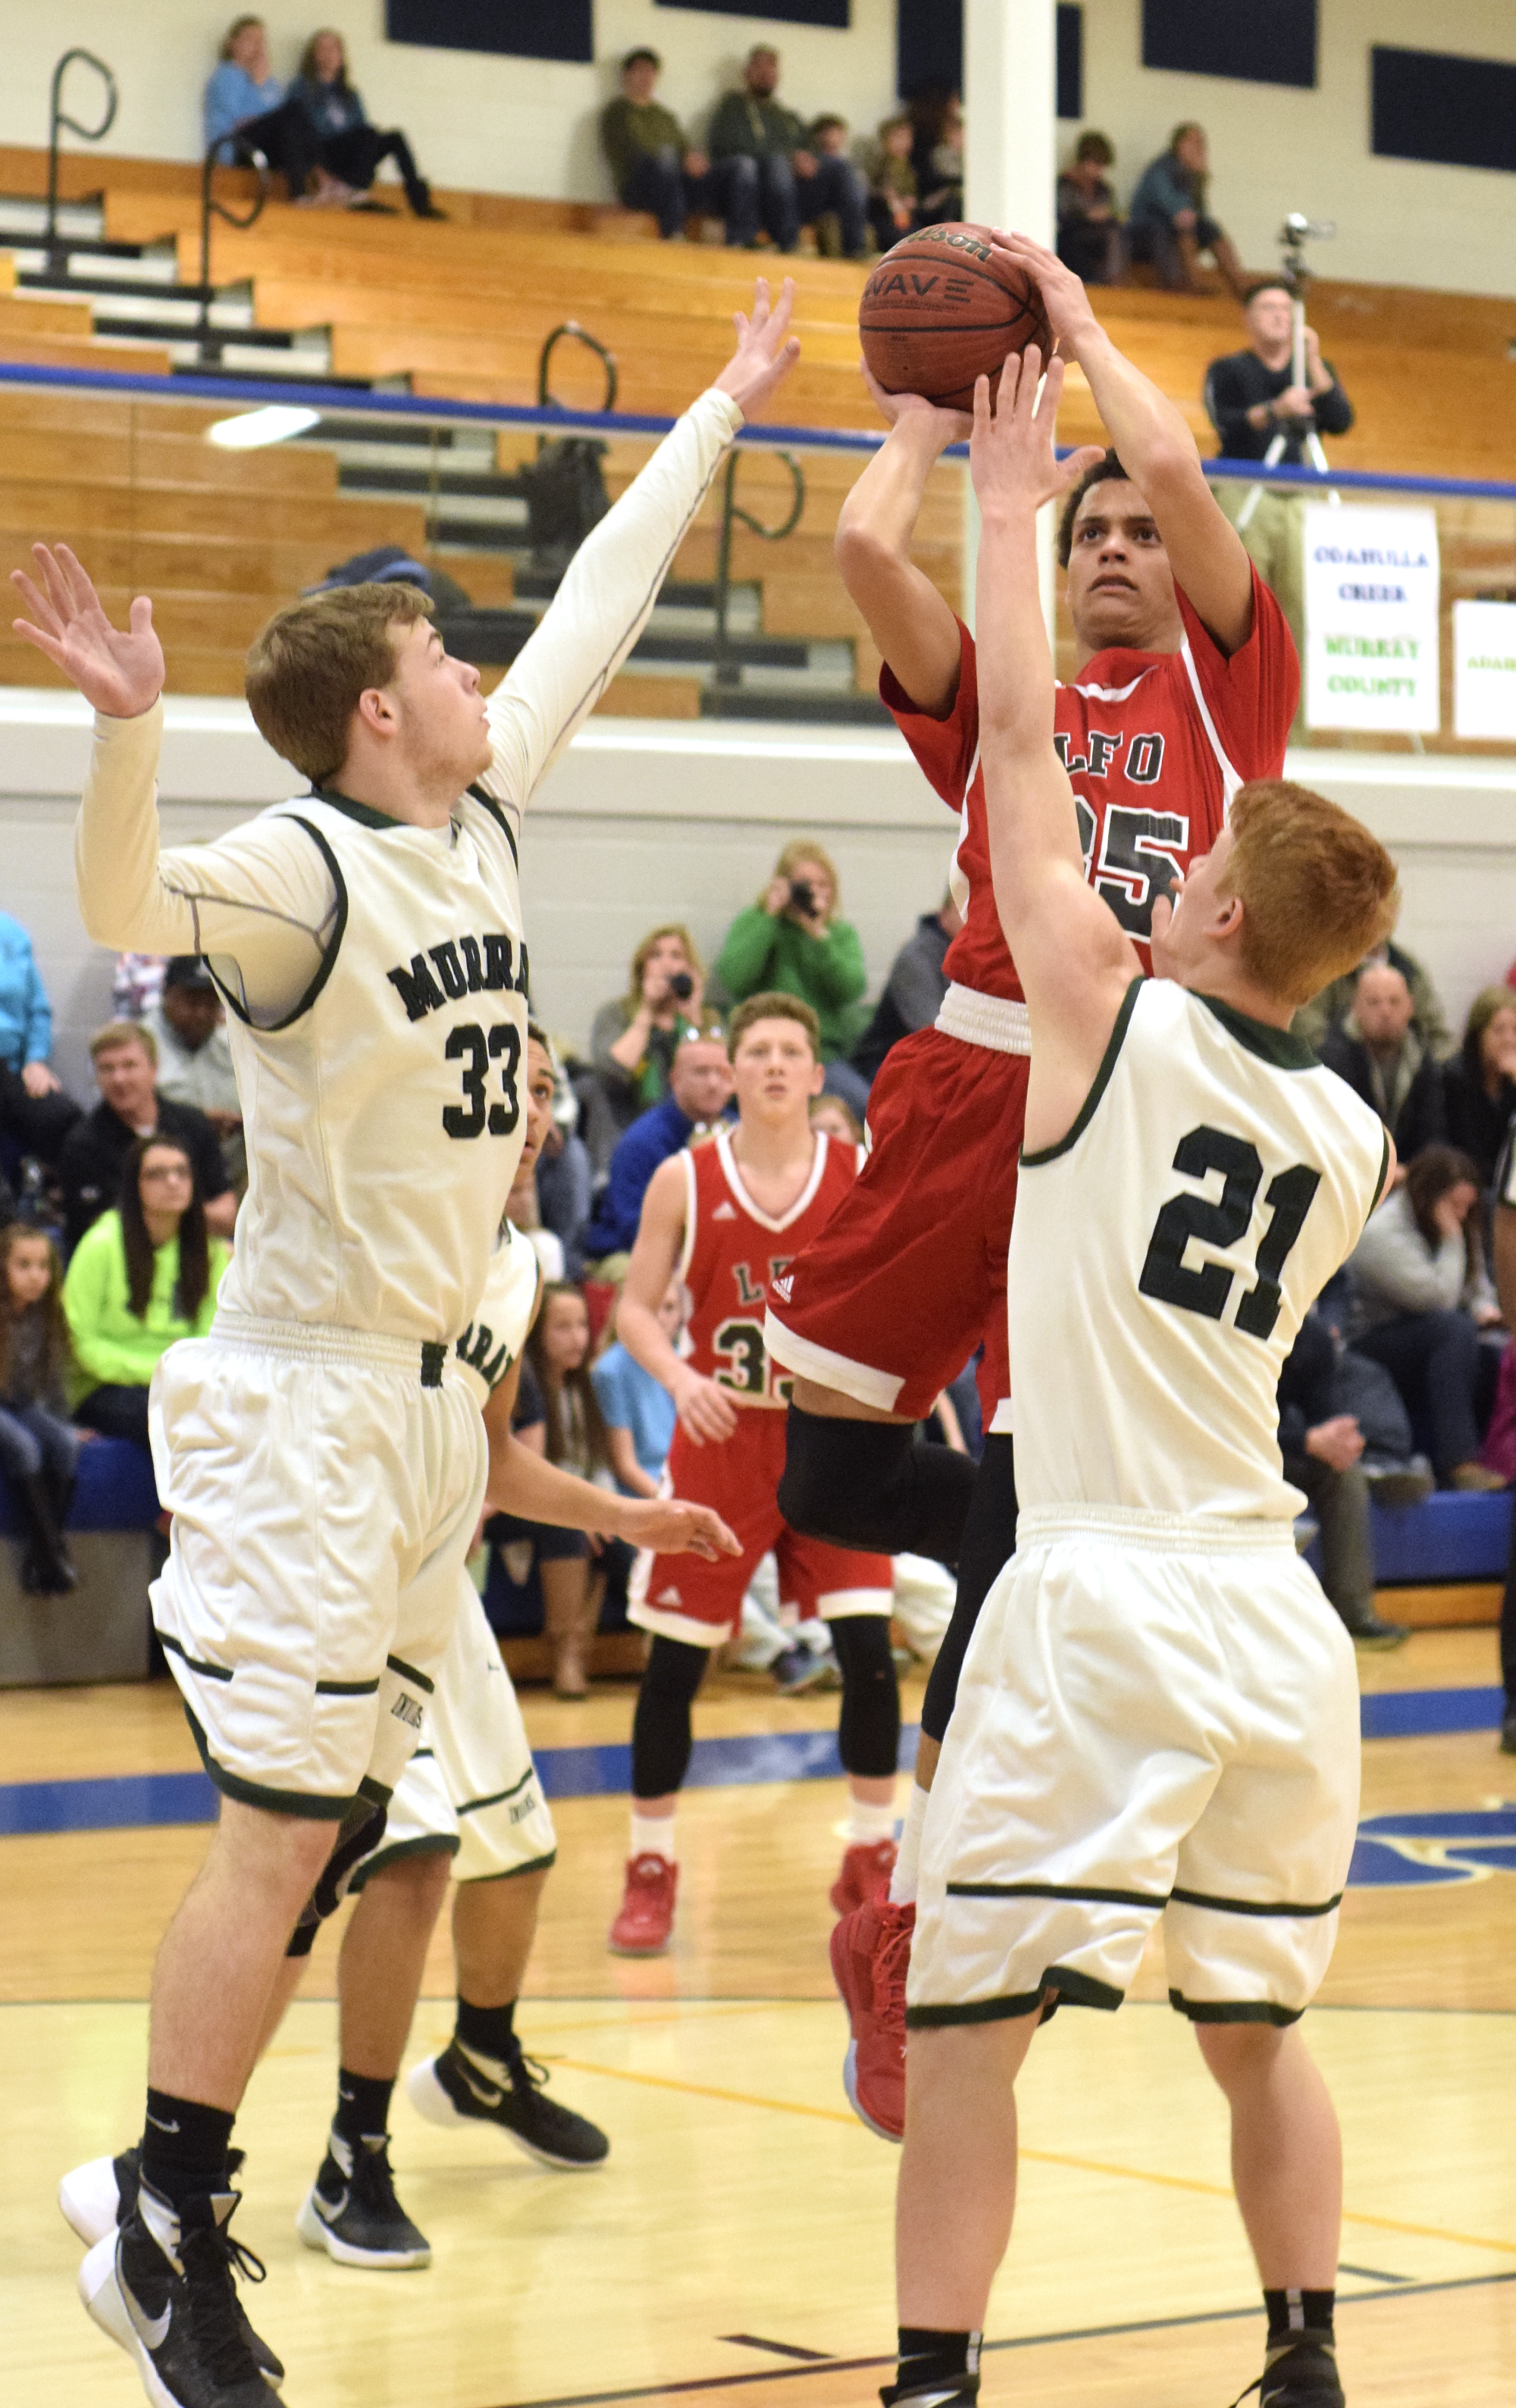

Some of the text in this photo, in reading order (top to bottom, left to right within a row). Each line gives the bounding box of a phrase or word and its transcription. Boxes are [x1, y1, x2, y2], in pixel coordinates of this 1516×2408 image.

[1338, 582, 1408, 603] CREEK
[1325, 635, 1420, 659] MURRAY
[1326, 675, 1416, 697] COUNTY
[1054, 730, 1165, 785] LFO
[442, 1022, 521, 1140] 33
[1139, 1123, 1323, 1342] 21
